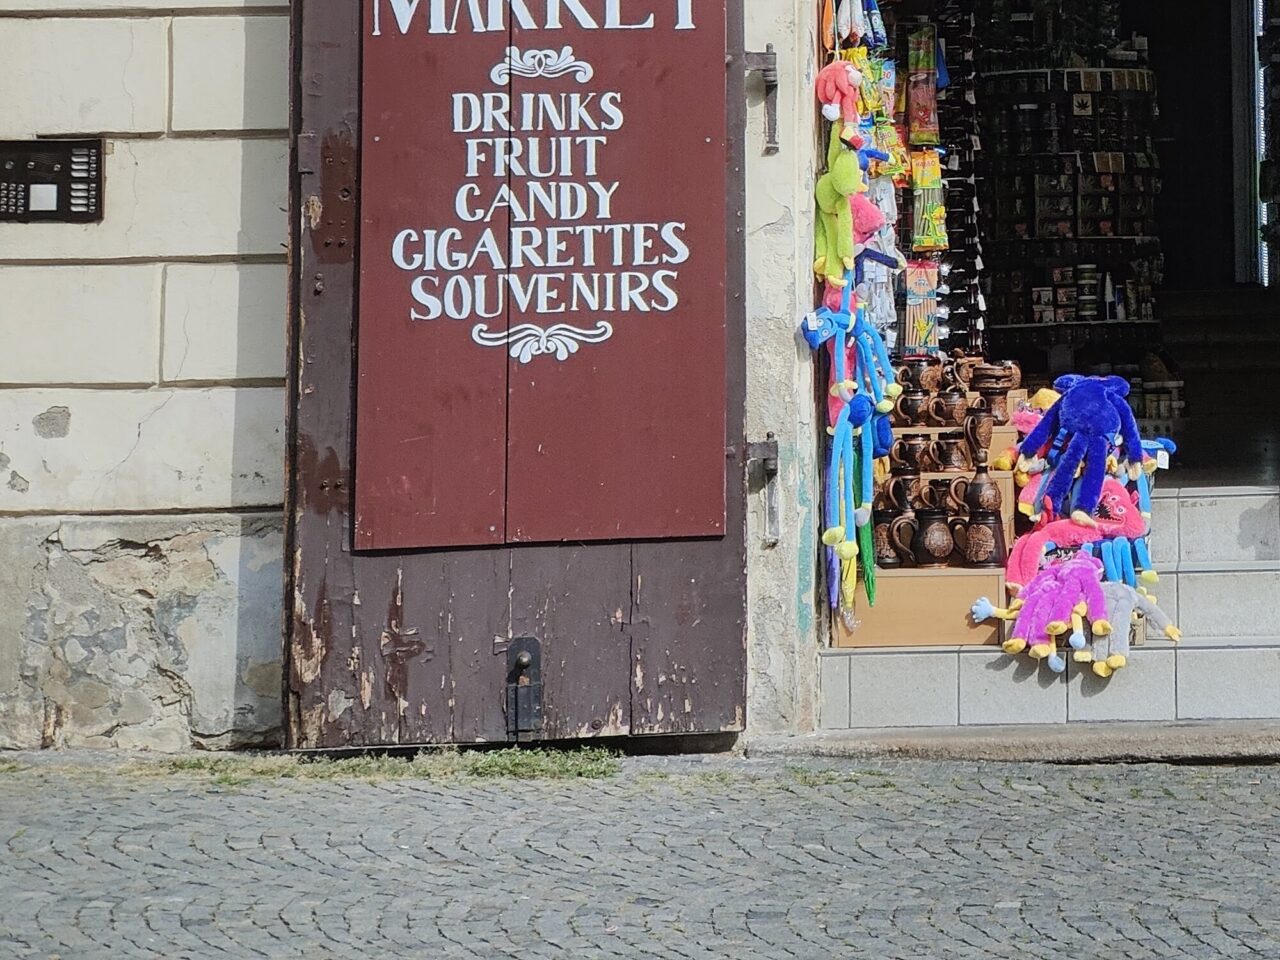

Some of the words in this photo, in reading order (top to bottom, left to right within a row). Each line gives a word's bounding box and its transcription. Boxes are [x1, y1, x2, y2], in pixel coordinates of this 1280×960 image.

[452, 92, 623, 132] DRINKS
[466, 136, 606, 177] FRUIT
[456, 181, 619, 222] CANDY
[392, 222, 689, 270] CIGARETTES
[411, 270, 678, 320] SOUVENIRS
